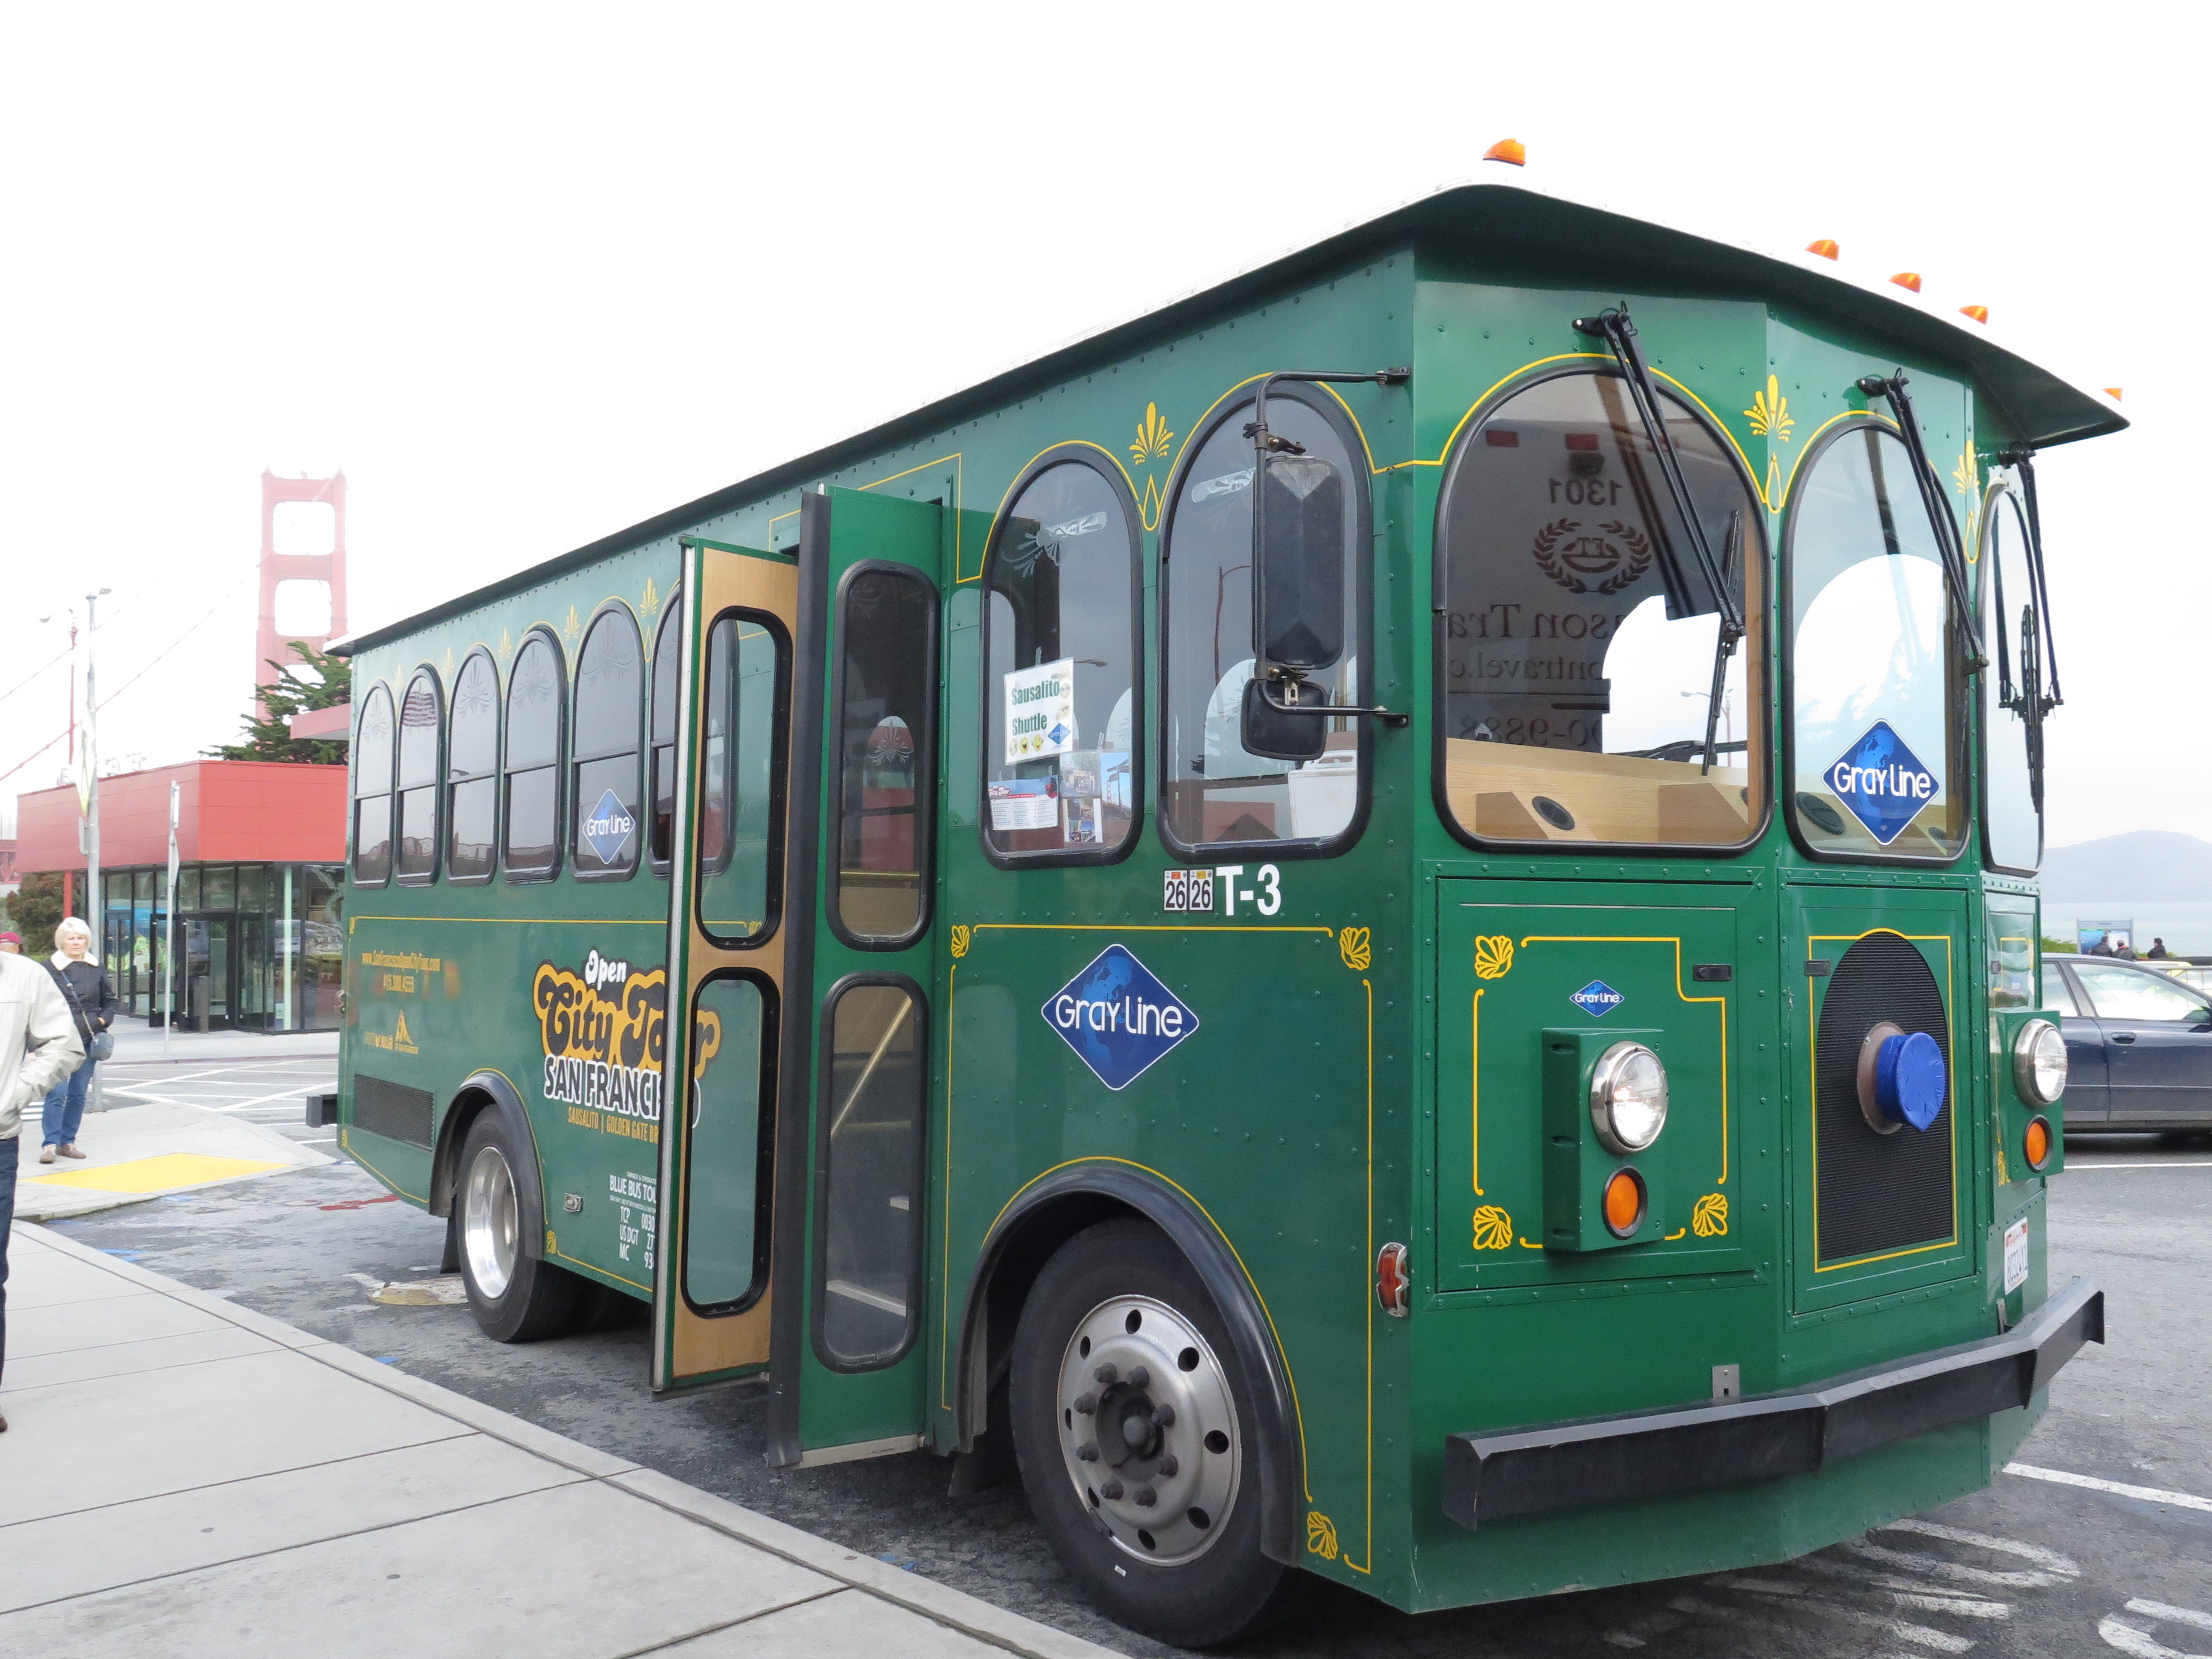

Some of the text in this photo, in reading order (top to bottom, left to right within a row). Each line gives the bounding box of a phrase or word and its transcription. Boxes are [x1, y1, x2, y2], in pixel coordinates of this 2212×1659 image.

[1011, 680, 1060, 706] Sausalito
[1012, 713, 1047, 736] Shuttle
[1165, 880, 1186, 909] 26
[1191, 880, 1211, 909] 26
[1216, 864, 1282, 916] T-3
[586, 950, 627, 990] Open
[537, 974, 613, 1064] City
[545, 1053, 581, 1104] SAN
[568, 1107, 599, 1129] SAUSALITO
[607, 1115, 630, 1136] GOLDEN
[632, 1121, 648, 1141] GATE
[609, 1175, 627, 1195] BLUE
[628, 1180, 641, 1199] BUS
[620, 1206, 630, 1224] TCP
[619, 1243, 630, 1261] MC
